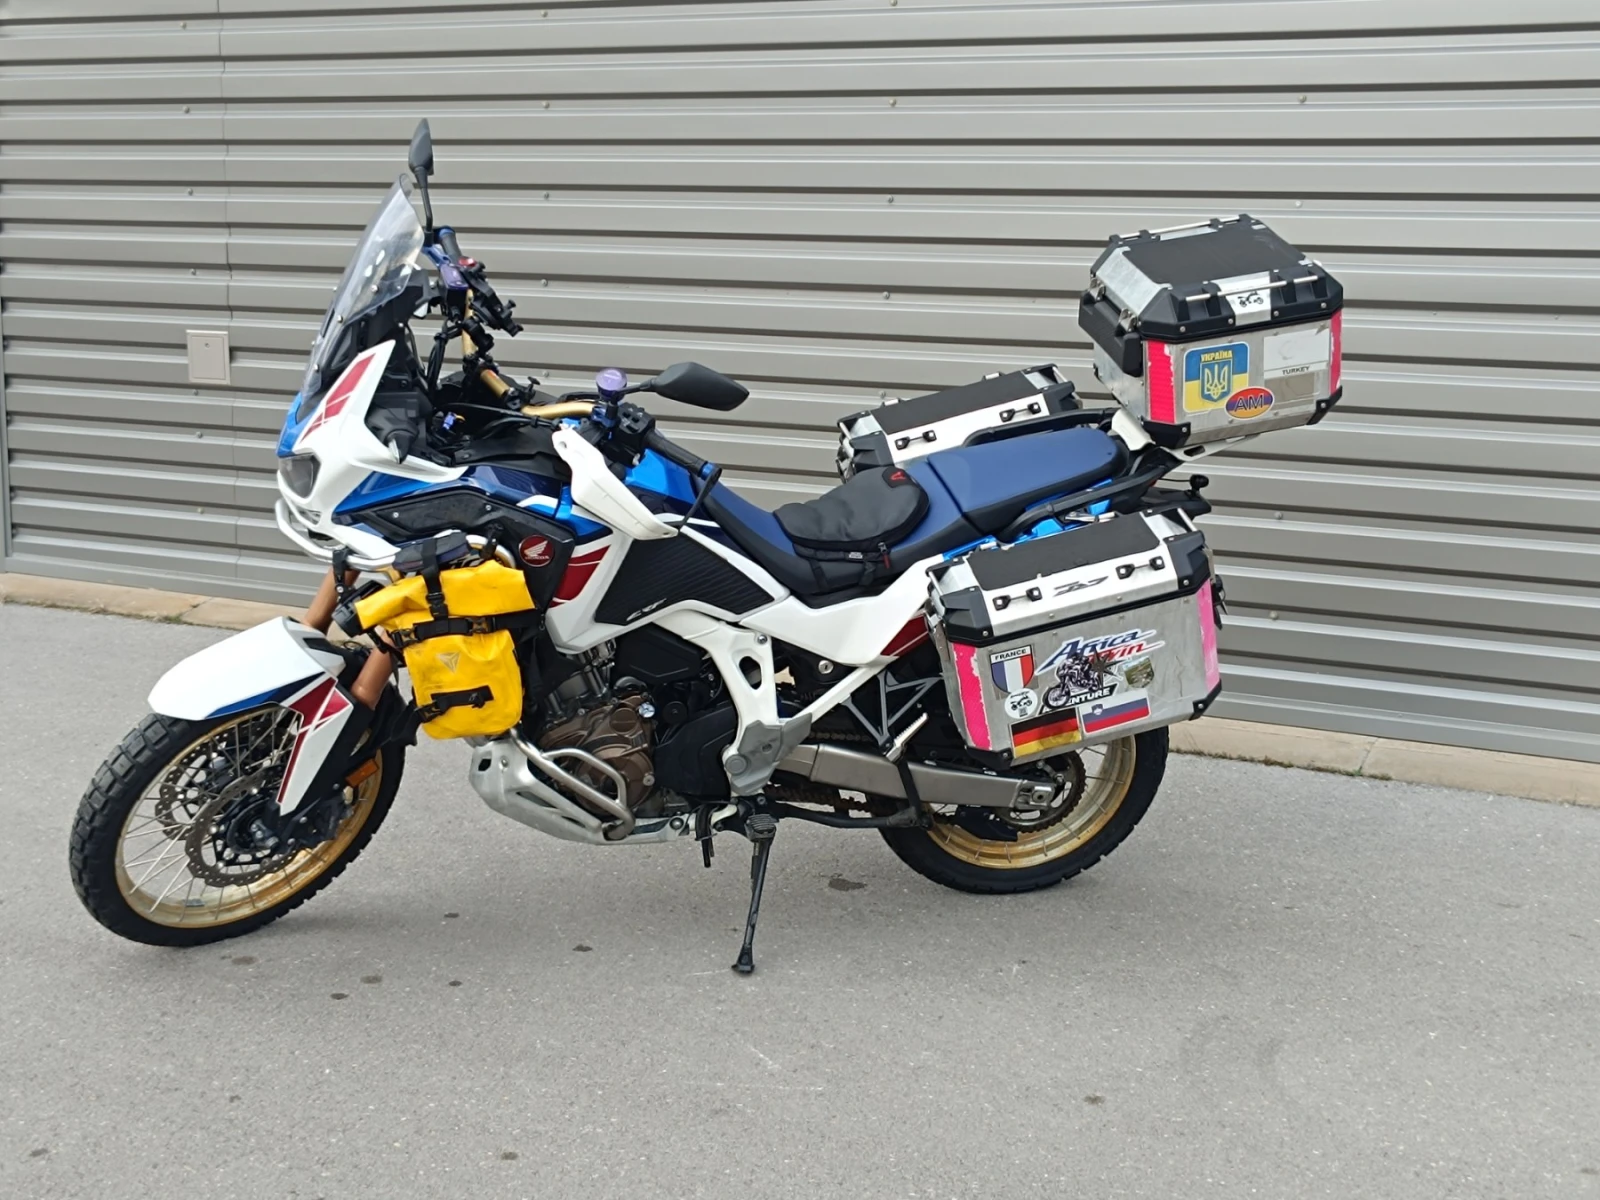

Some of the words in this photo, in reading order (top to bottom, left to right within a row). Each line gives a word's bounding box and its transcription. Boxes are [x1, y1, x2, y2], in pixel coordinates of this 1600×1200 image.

[1201, 350, 1232, 362] УКРАЇНА
[1282, 366, 1310, 375] TURKEY
[1234, 393, 1265, 412] AM
[994, 648, 1027, 661] FRANCE
